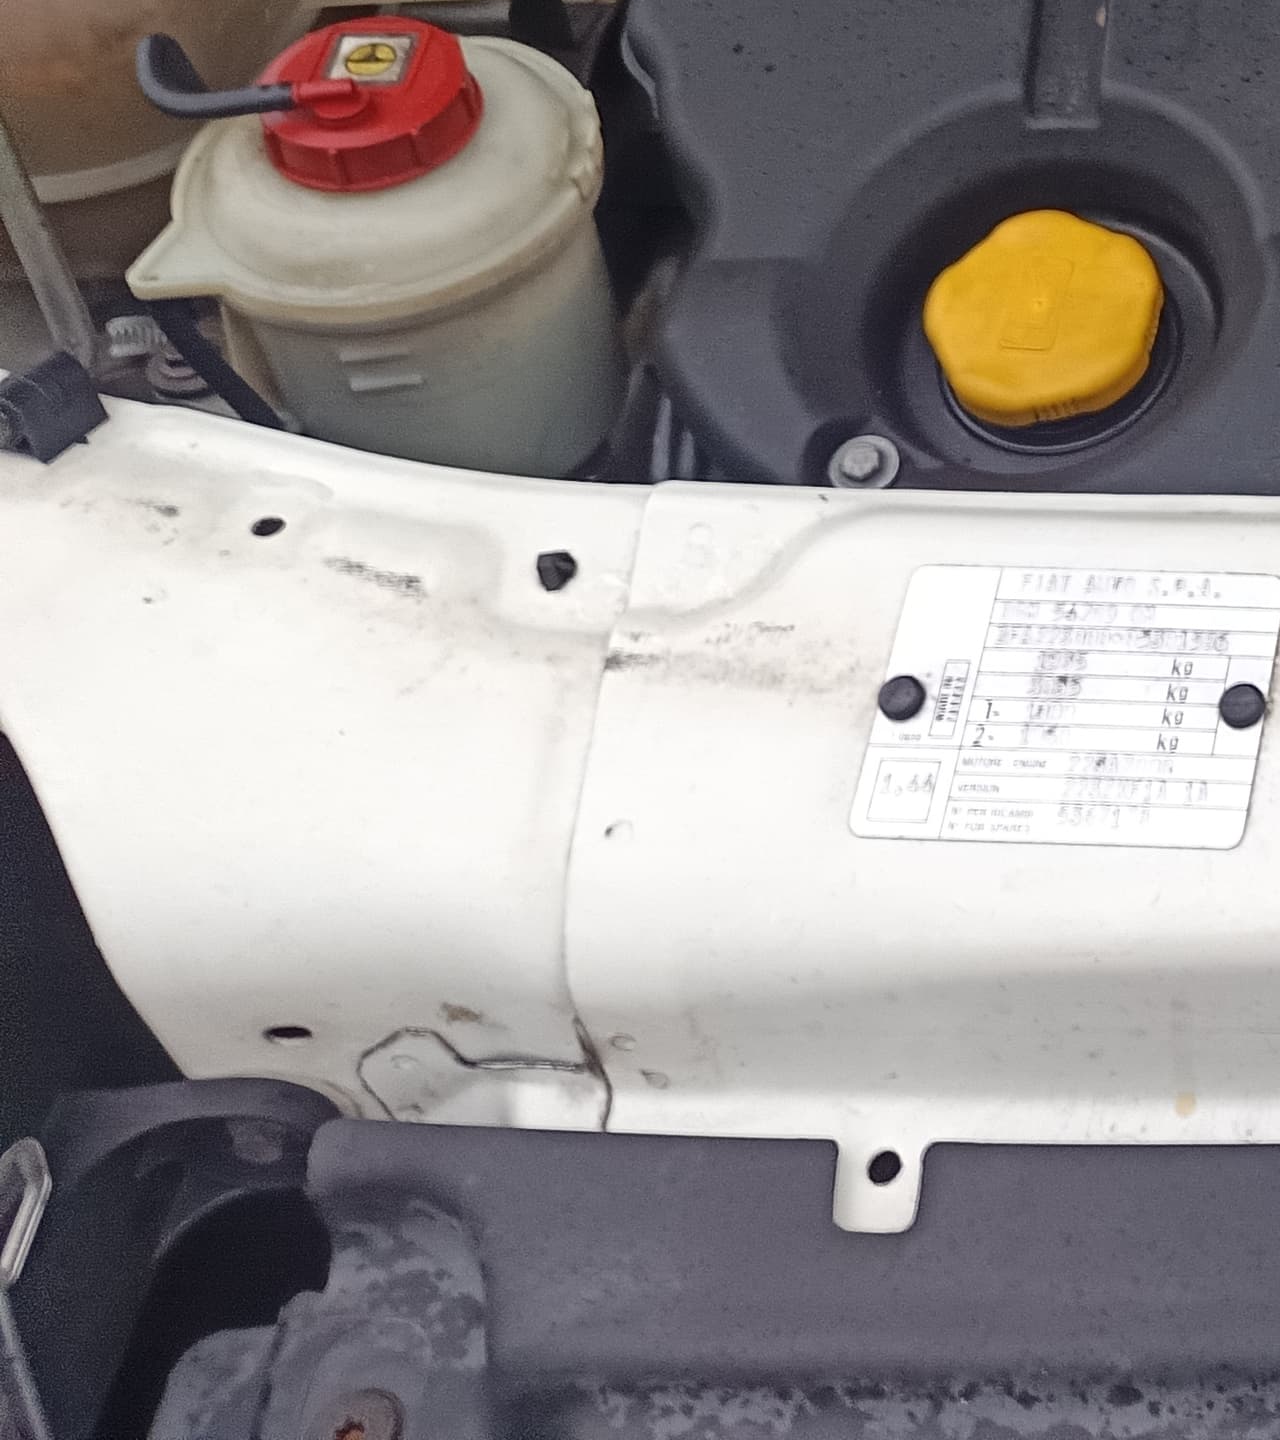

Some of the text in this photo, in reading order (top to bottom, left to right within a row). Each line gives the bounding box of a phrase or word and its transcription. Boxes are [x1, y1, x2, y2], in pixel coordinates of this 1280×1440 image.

[1021, 573, 1073, 594] FIAT
[1171, 658, 1194, 678] kg
[1166, 683, 1189, 703] kg
[1161, 707, 1184, 728] kg
[1156, 733, 1180, 753] kg
